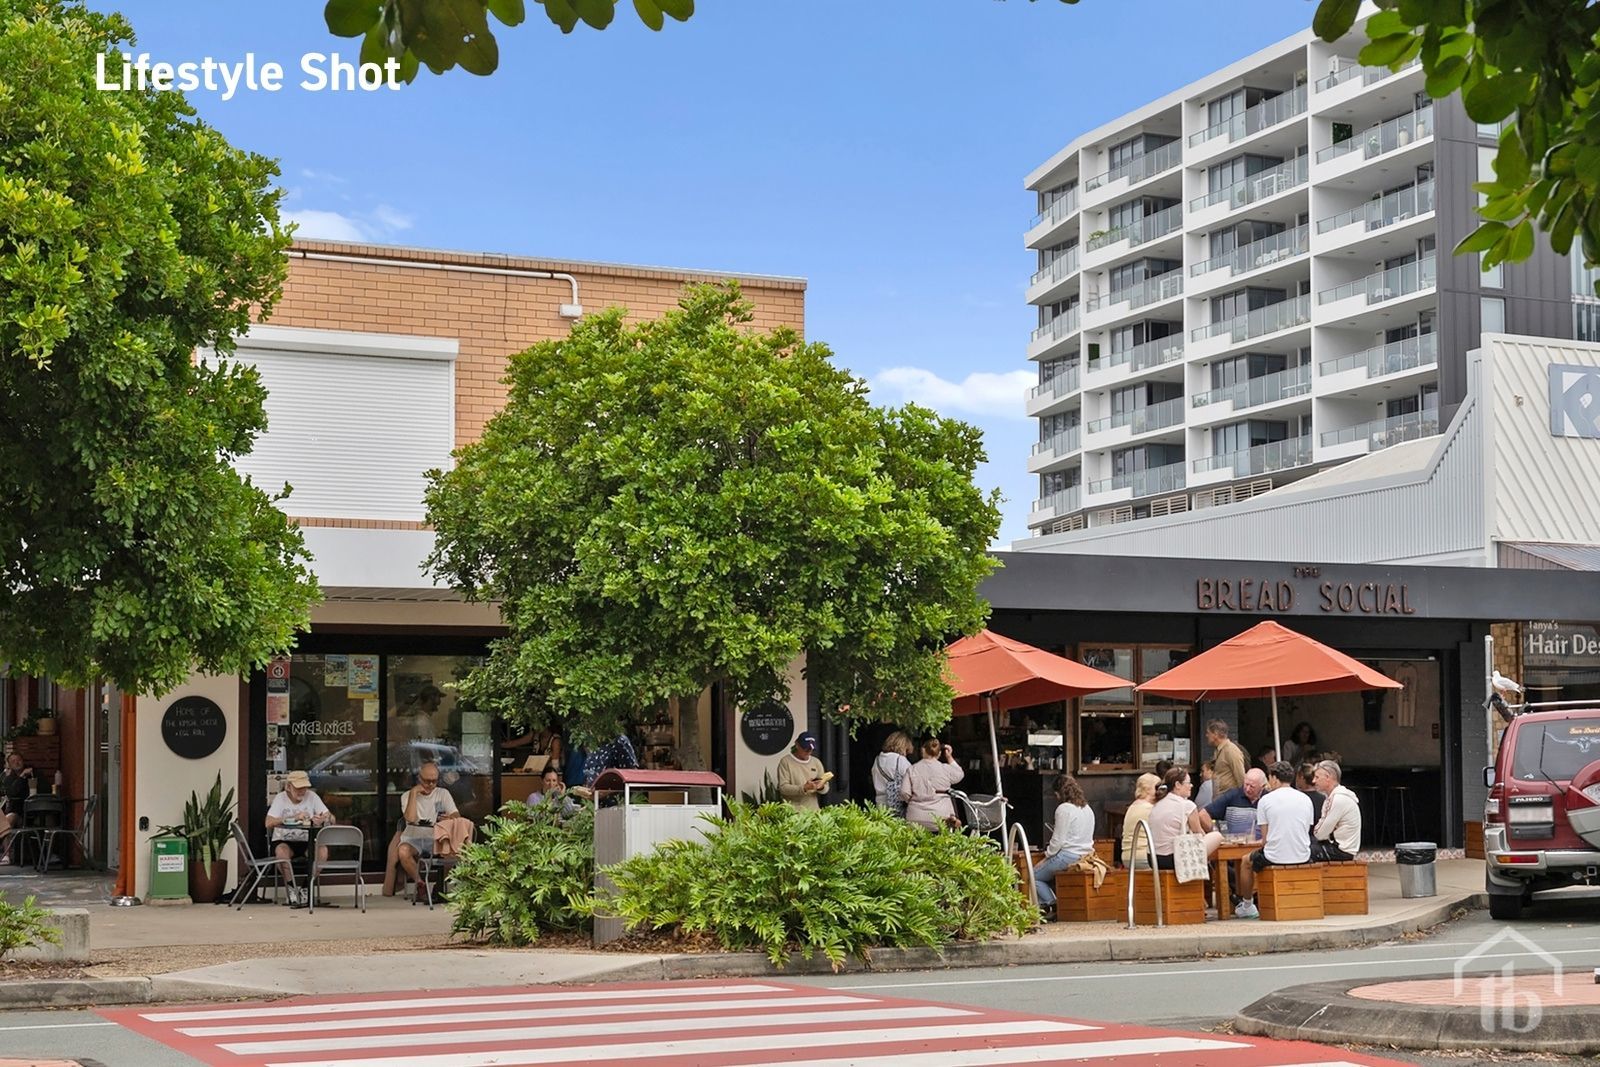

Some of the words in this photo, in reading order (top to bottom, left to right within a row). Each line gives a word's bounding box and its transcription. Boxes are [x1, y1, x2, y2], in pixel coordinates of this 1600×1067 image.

[1197, 578, 1295, 611] BREAD
[1320, 581, 1416, 615] SOCIAL
[1529, 633, 1568, 655] Hair
[1573, 633, 1600, 655] De
